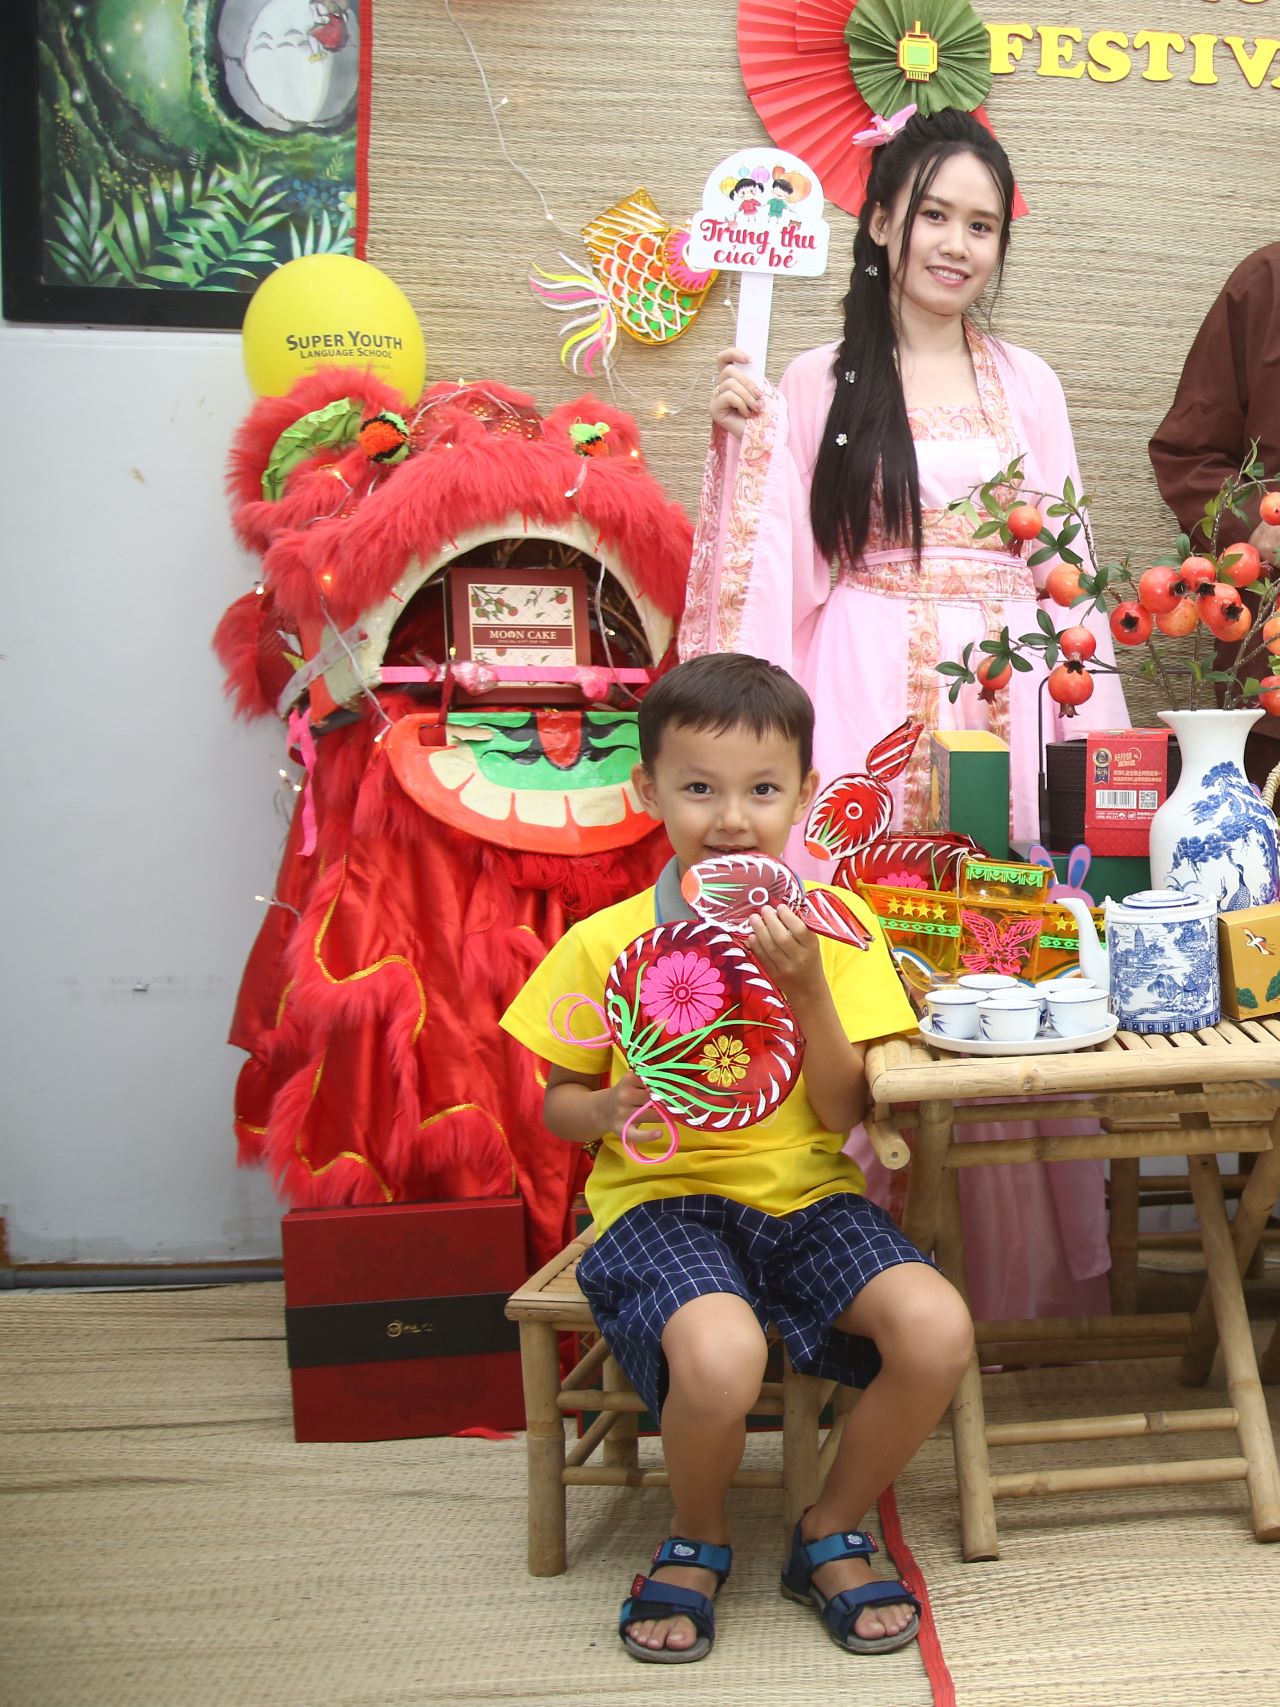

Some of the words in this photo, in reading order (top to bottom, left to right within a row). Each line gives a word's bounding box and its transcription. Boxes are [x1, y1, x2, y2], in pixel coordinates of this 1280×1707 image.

[700, 219, 770, 254] Trung
[780, 225, 816, 249] thu
[714, 245, 759, 265] của
[768, 247, 798, 268] bé
[286, 334, 344, 351] SUPER
[348, 330, 403, 350] YOUTH
[300, 349, 354, 359] LANGUAGE
[357, 348, 392, 358] SCHOOL
[489, 630, 525, 639] MOON
[528, 630, 557, 640] CAKE
